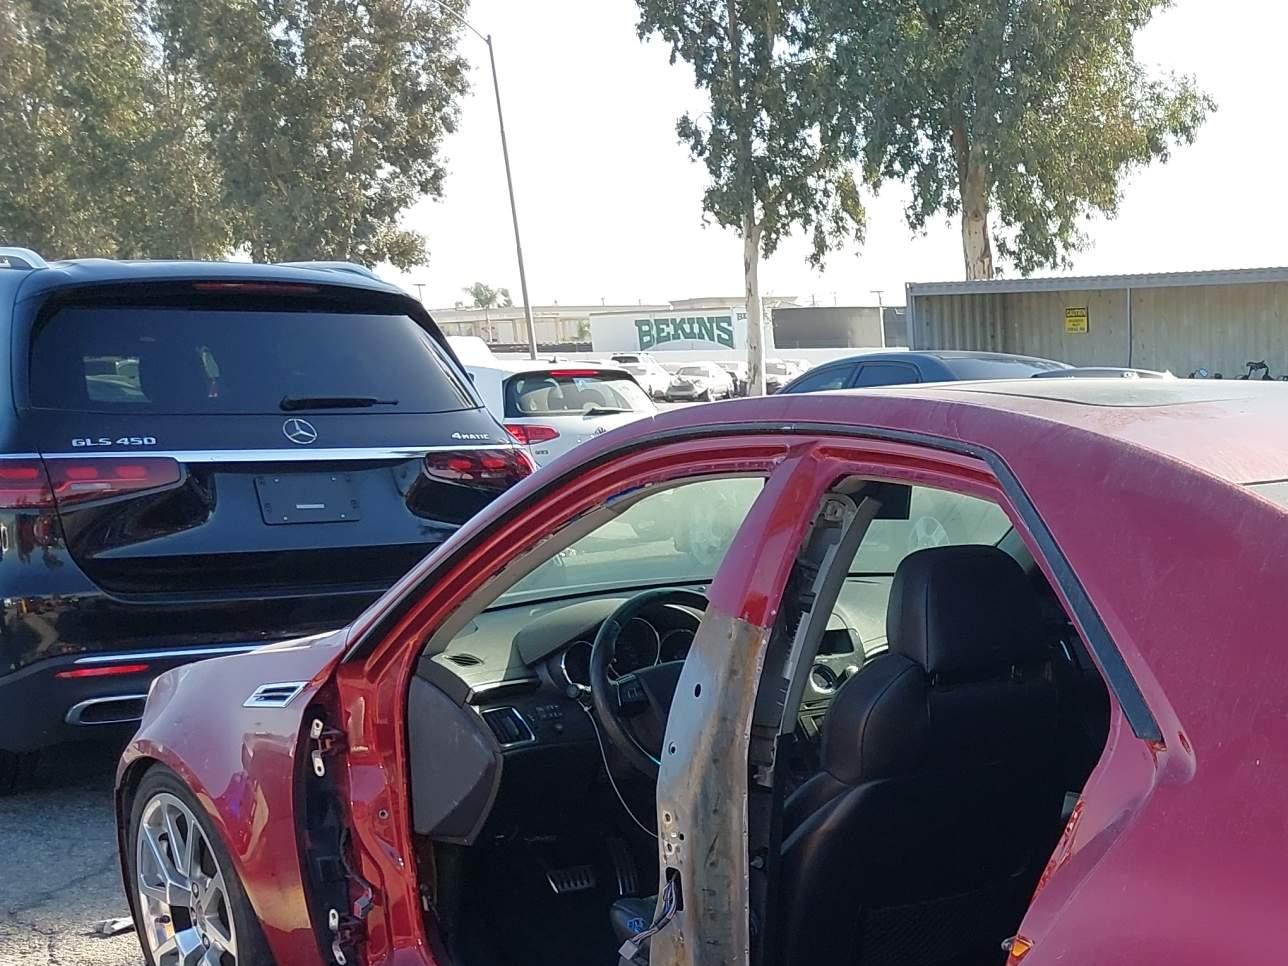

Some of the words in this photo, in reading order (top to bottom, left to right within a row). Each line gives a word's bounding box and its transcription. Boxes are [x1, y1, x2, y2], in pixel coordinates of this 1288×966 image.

[634, 316, 736, 351] BEKINS
[71, 437, 112, 447] GLS
[115, 436, 157, 446] 450
[452, 432, 490, 440] 4MATIC
